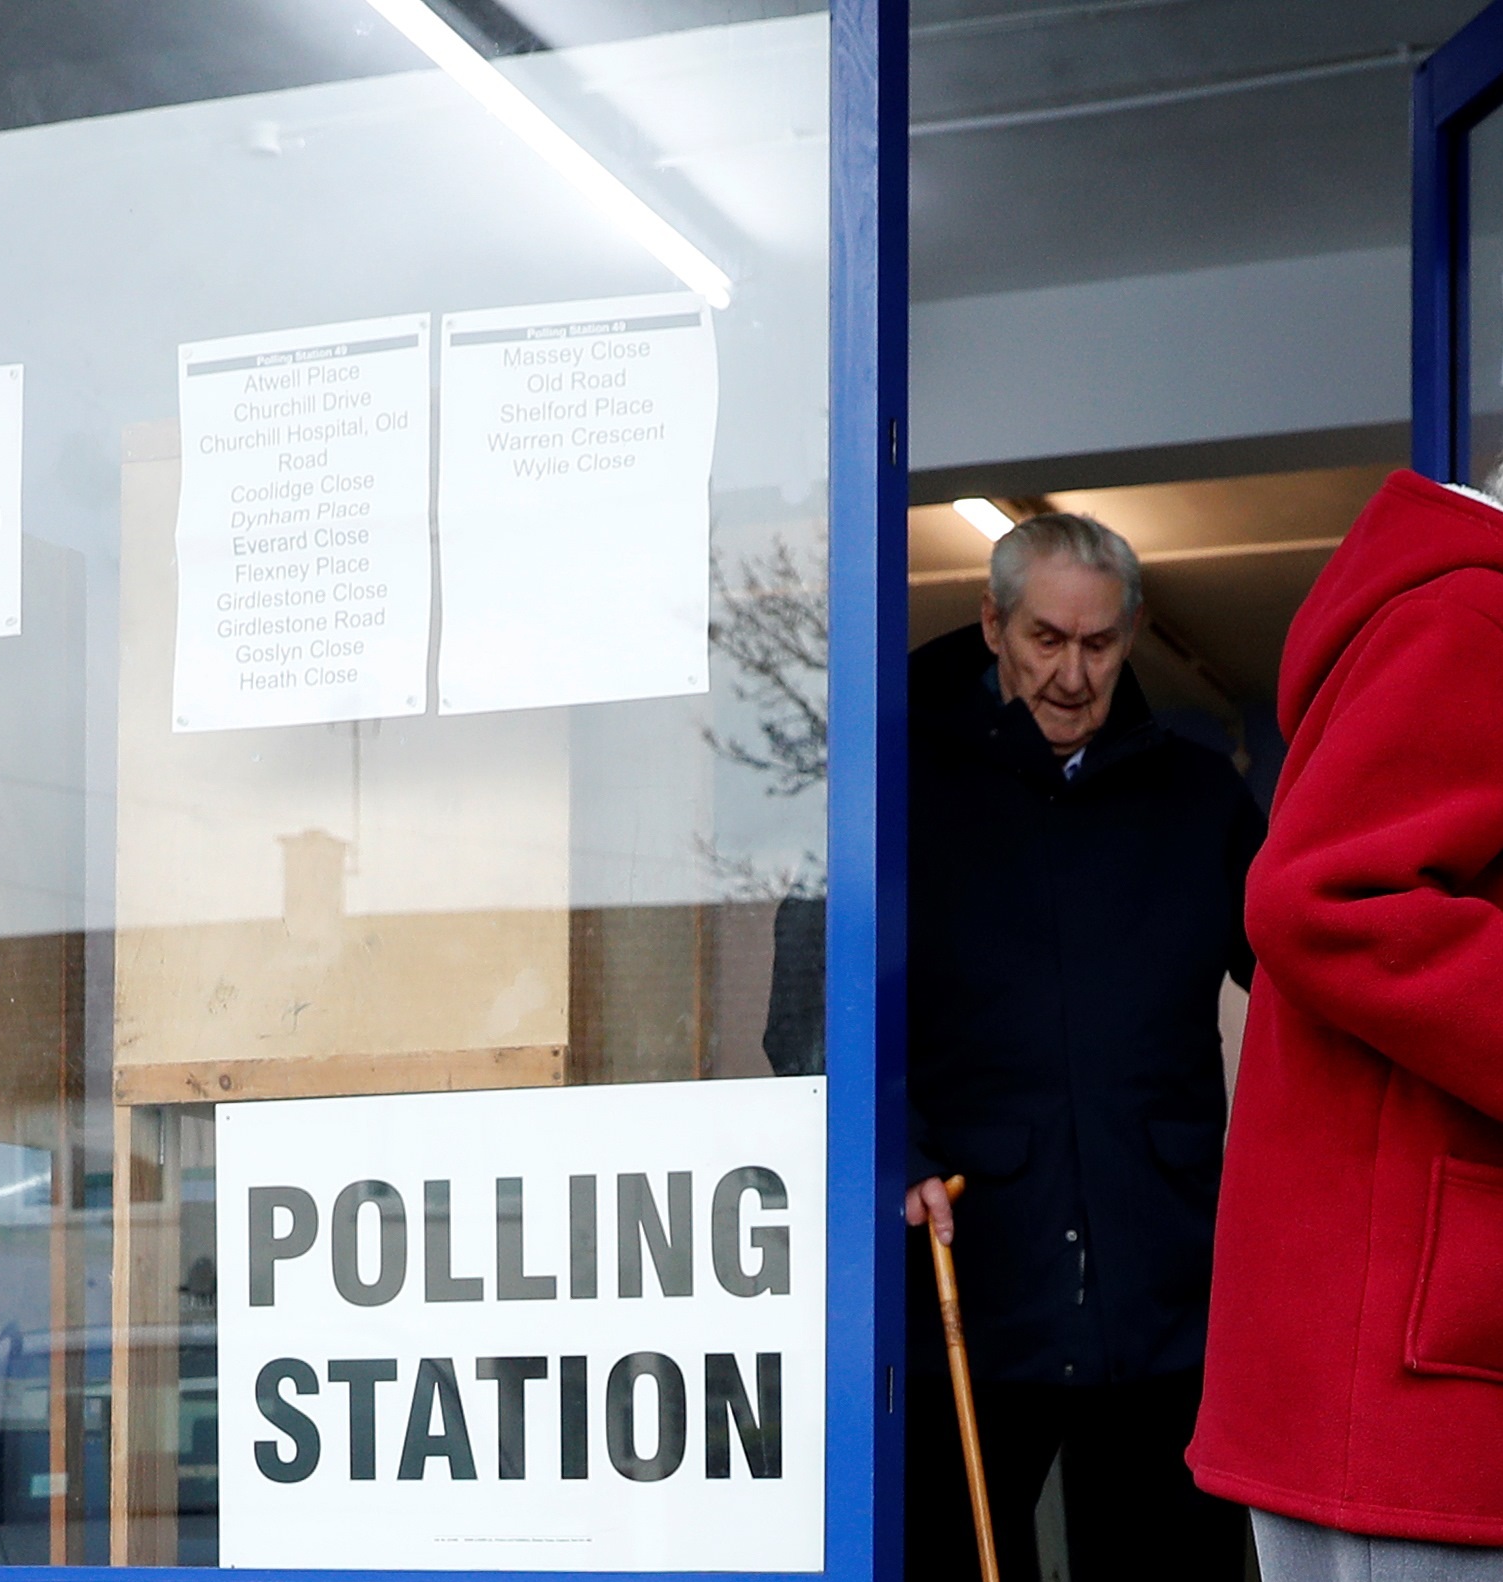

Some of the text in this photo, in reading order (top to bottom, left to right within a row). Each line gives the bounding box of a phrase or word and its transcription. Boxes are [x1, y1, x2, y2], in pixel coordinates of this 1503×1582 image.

[526, 326, 567, 341] Polling
[569, 323, 611, 337] Station
[255, 352, 294, 367] Polling
[503, 339, 651, 368] Massey Close
[244, 363, 361, 394] Atwell Place
[527, 367, 627, 393] Old Road
[233, 389, 372, 422] Churchill Drive
[500, 396, 654, 424] Shelford Place
[199, 410, 409, 454] Churchill Hospital, Old
[487, 421, 666, 453] Warren Crescent
[278, 448, 329, 473] Road
[513, 452, 637, 481] Wylie Close
[230, 472, 375, 504] Coolidge Close
[231, 500, 371, 532] Dynham Place
[232, 527, 370, 557] Everard Close
[235, 555, 370, 584] Flexney Place
[216, 581, 389, 612] Girdlestone Close
[216, 607, 386, 639] Girdlestone Road
[235, 639, 365, 666] Goslyn Close
[239, 666, 359, 691] Heath Close
[248, 1165, 791, 1308] POLLING
[253, 1350, 784, 1484] STATION
